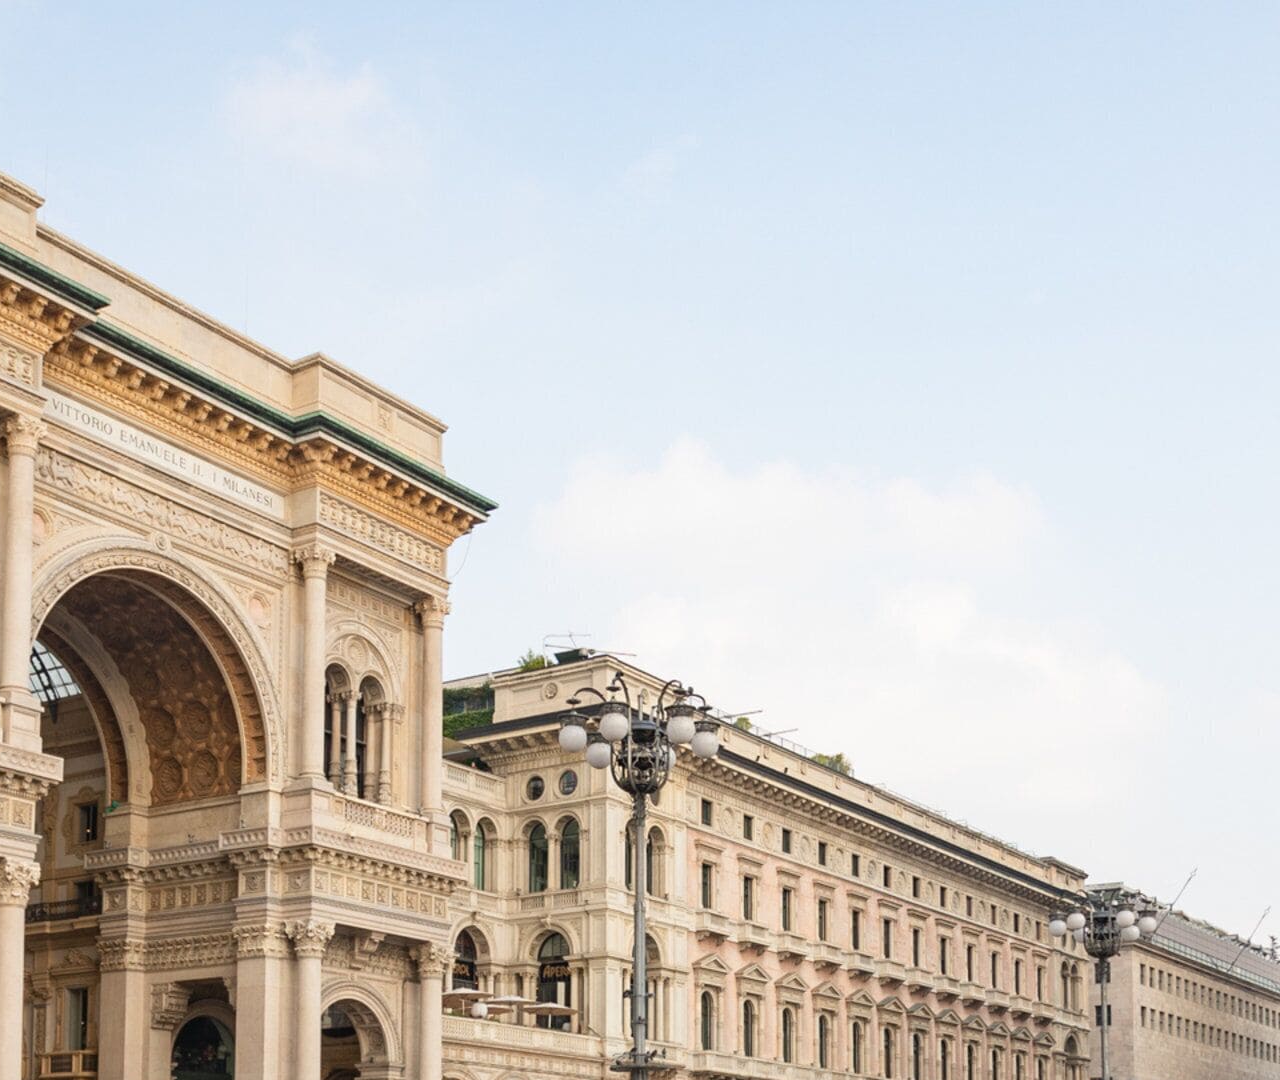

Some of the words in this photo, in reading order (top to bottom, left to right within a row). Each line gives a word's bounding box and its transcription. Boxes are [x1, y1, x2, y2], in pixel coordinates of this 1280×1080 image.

[51, 398, 114, 436] VITTORIO
[120, 429, 187, 470] EMANUELE
[223, 476, 274, 509] MILANESI
